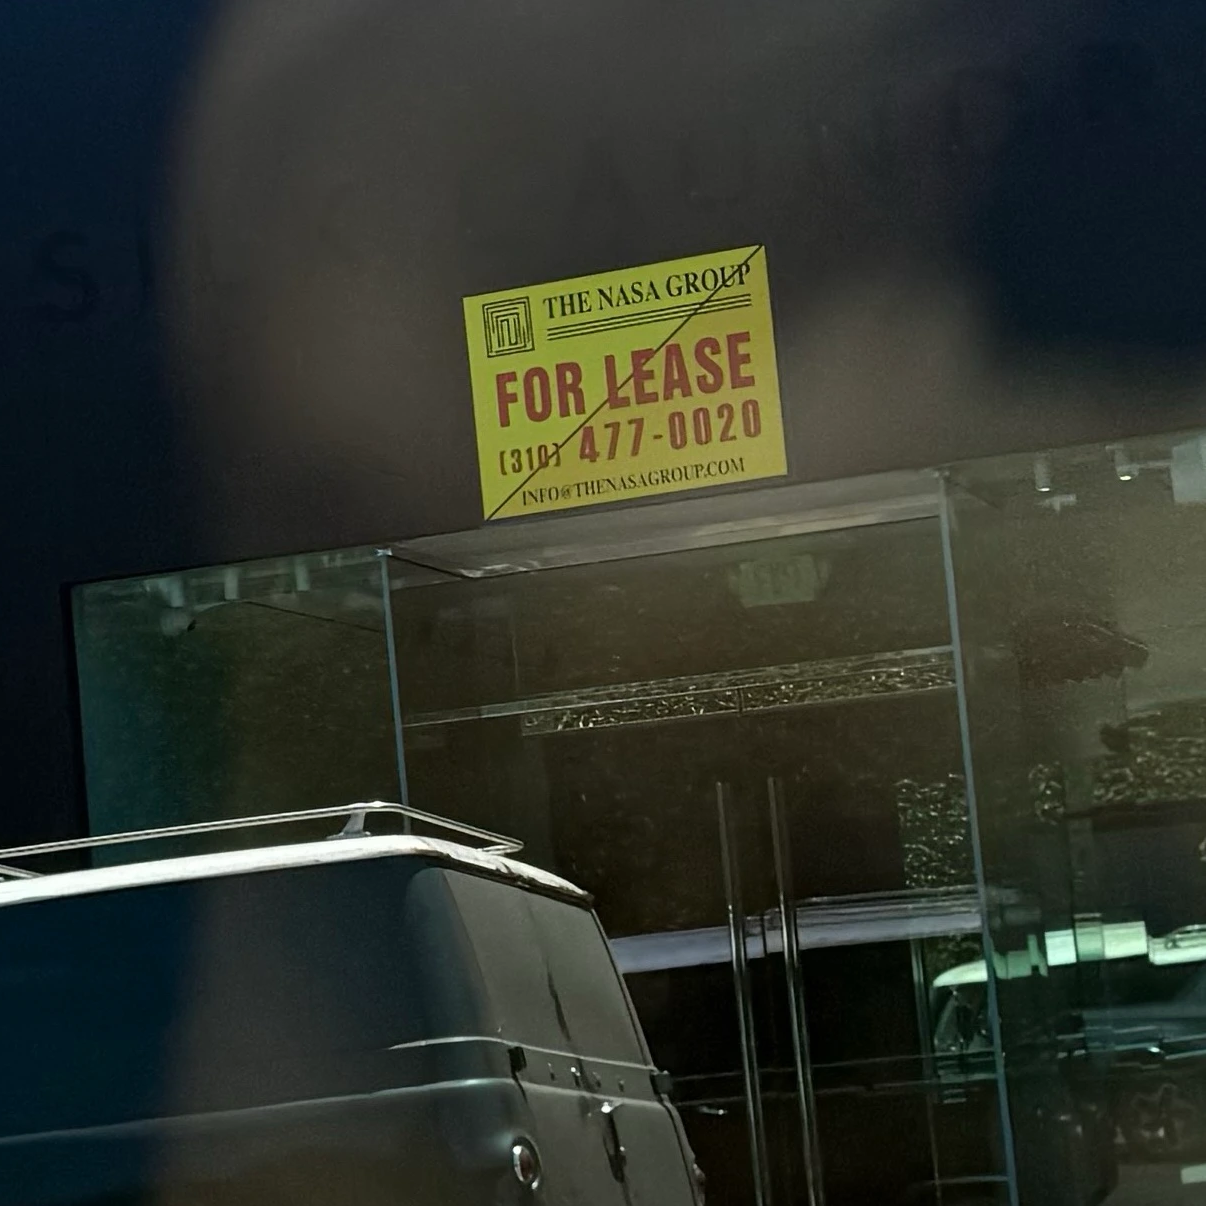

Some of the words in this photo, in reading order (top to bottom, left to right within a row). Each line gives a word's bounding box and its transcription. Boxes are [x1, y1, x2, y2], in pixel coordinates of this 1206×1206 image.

[543, 291, 593, 320] THE
[597, 280, 660, 309] NASA
[665, 263, 751, 298] GROUP
[495, 361, 586, 428] FOR
[604, 331, 756, 409] LEASE
[499, 443, 561, 476] (310)
[579, 399, 762, 463] 477-0020
[522, 457, 746, 506] INFO@THENASAGROUP.COM
